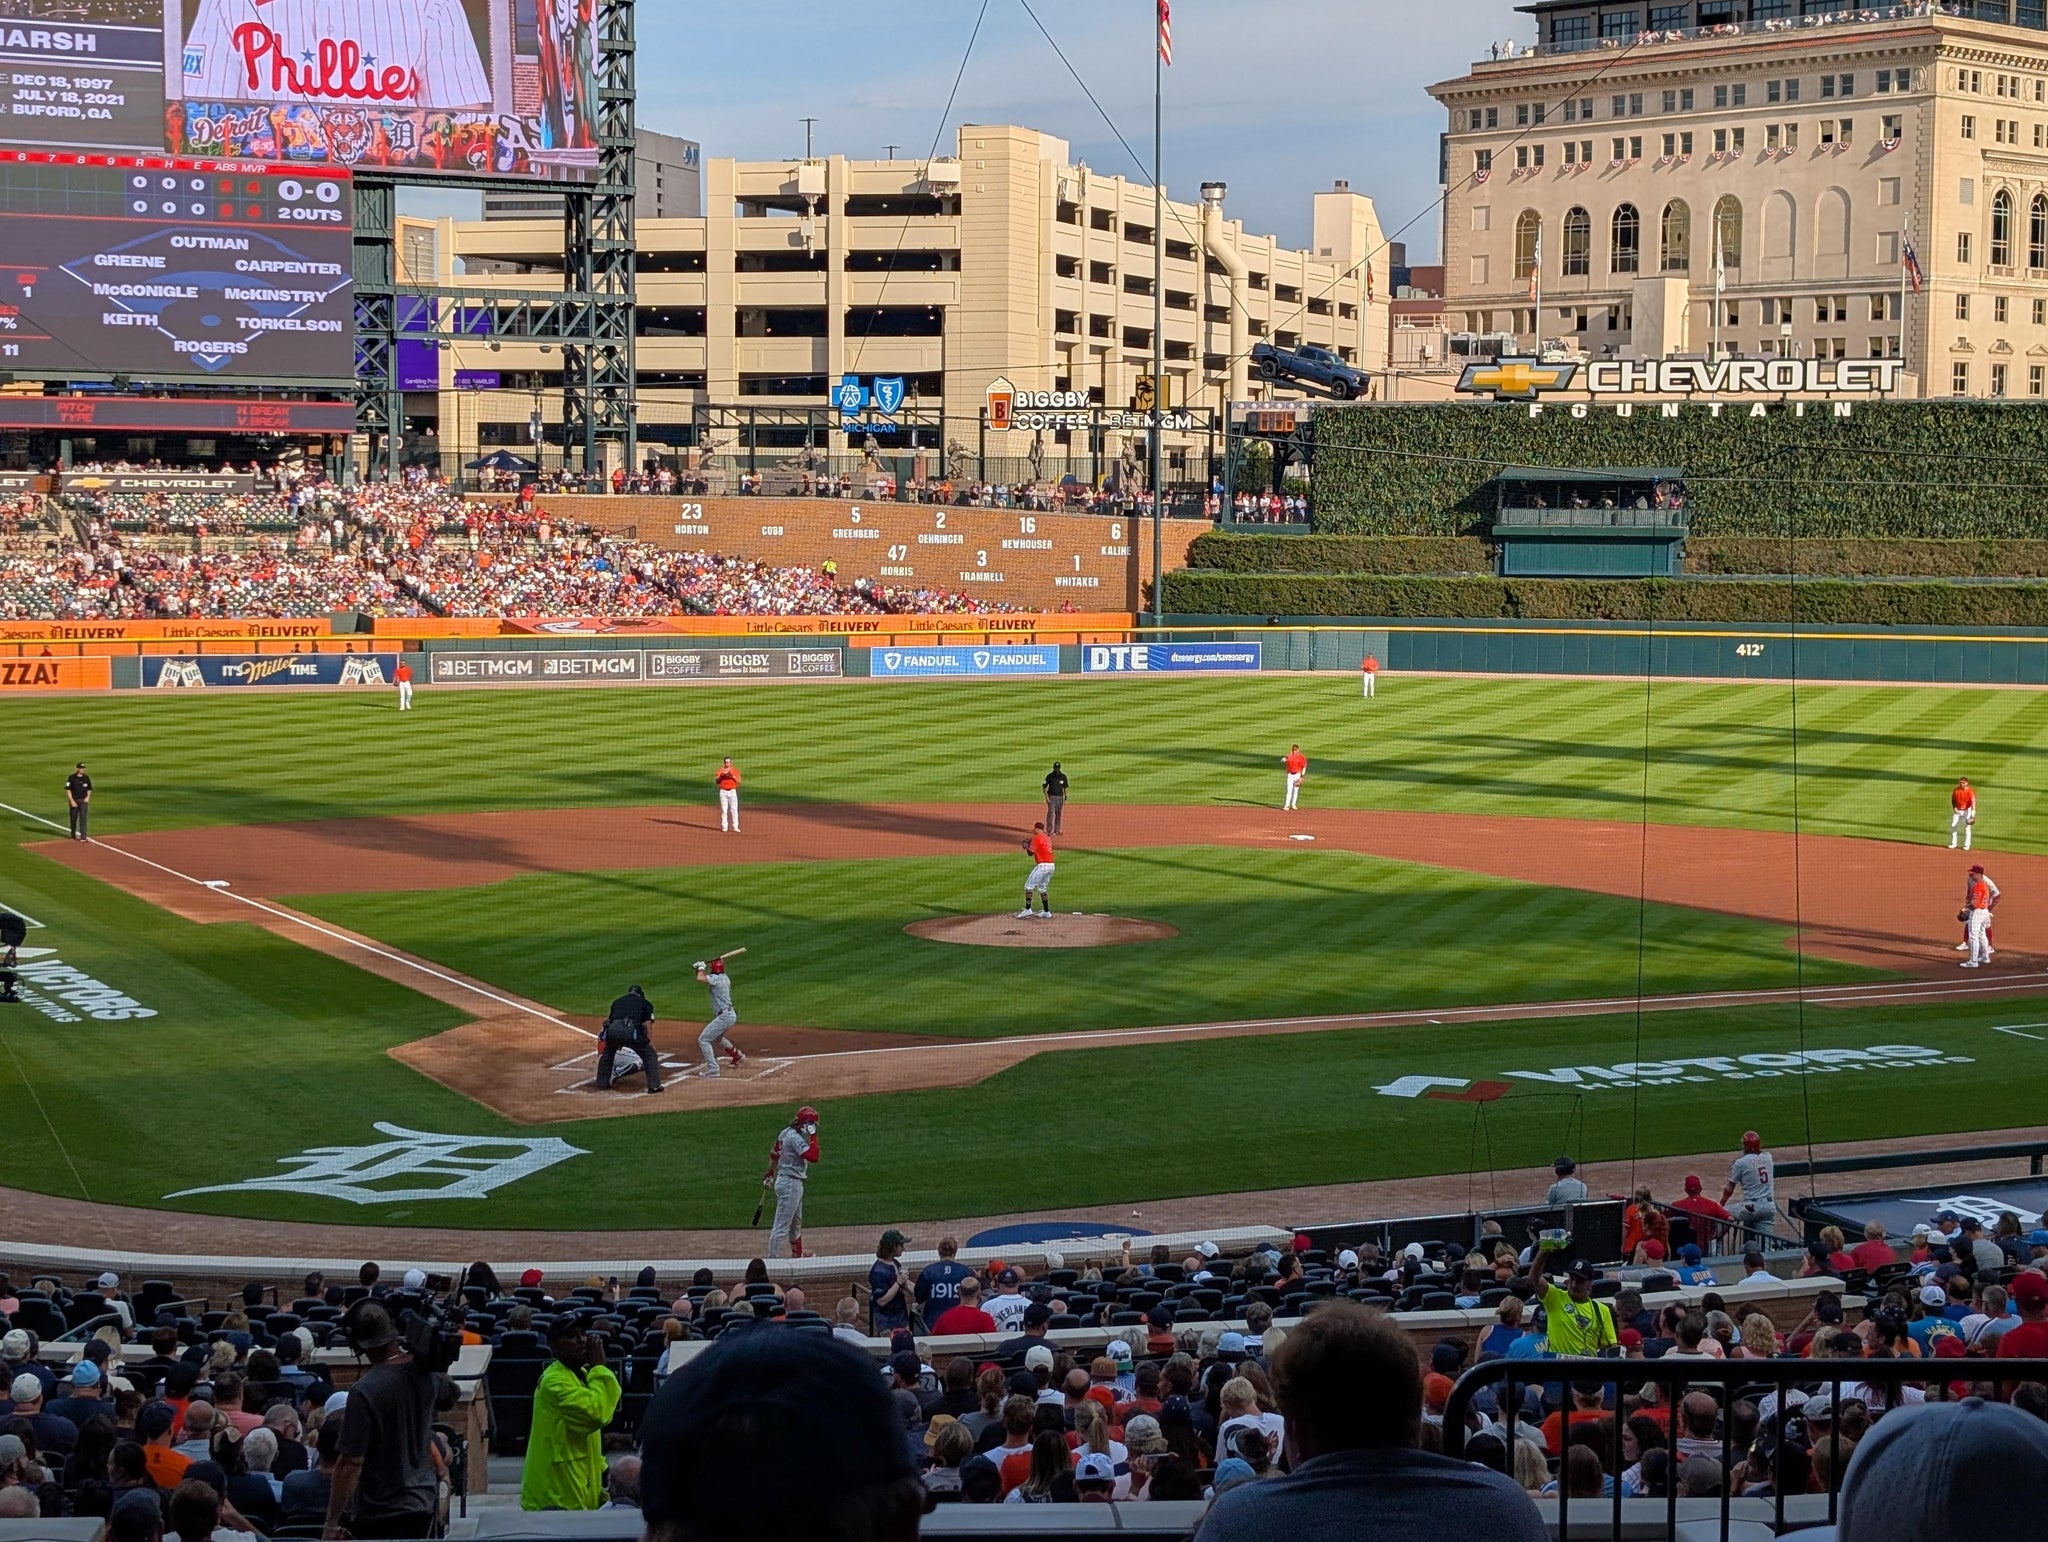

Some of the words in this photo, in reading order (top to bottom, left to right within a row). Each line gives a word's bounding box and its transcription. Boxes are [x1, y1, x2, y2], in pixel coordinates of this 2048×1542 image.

[0, 28, 96, 52] ARSH
[233, 22, 421, 101] Phillies
[12, 74, 46, 86] DEC
[49, 76, 71, 89] 18,
[73, 78, 113, 90] 1997
[12, 89, 58, 101] JULY
[60, 92, 82, 105] 18,
[84, 93, 125, 105] 2021
[12, 104, 86, 120] BUFORD,
[87, 108, 113, 119] GA
[191, 106, 270, 148] Detroit
[18, 153, 26, 161] 6
[48, 154, 56, 162] 7
[77, 155, 86, 164] 8
[107, 157, 115, 166] 9
[136, 159, 145, 167] R
[164, 161, 174, 169] H
[194, 162, 202, 170] E
[214, 163, 237, 172] ABS
[241, 164, 266, 173] MVR
[133, 176, 147, 188] 0
[162, 177, 176, 190] 0
[191, 179, 205, 191] 0
[133, 200, 148, 213] 0
[162, 201, 177, 214] 0
[191, 203, 206, 215] 0
[278, 207, 290, 219] 2
[292, 209, 342, 221] OUTS
[170, 236, 249, 250] OUTMAN
[94, 254, 166, 268] GREENE
[235, 259, 342, 275] CARPENTER
[23, 286, 32, 297] 1
[94, 284, 198, 298] McGONIGLE
[225, 288, 328, 303] McKINSTRY
[103, 313, 158, 326] KEITH
[236, 317, 342, 332] TORKELSON
[174, 341, 248, 354] ROGERS
[1587, 358, 1906, 393] CHEVROLET
[56, 402, 95, 412] PITCH
[251, 406, 290, 416] BREAK
[1529, 402, 1852, 418] FOUNTAIN
[60, 413, 93, 423] TYPE
[251, 416, 290, 426] BREAK
[1015, 413, 1090, 431] COFFEE
[1110, 413, 1192, 430] BETMGM
[842, 422, 896, 434] MICHIGAN
[120, 479, 237, 489] CHEVROLET
[682, 503, 703, 520] 23
[851, 506, 861, 523] 5
[935, 511, 946, 529] 2
[1019, 516, 1036, 534] 16
[675, 524, 710, 536] HORTON
[761, 525, 784, 536] COBB
[832, 528, 880, 540] GREENBERG
[1110, 523, 1121, 540] 6
[1002, 538, 1053, 550] NEWHOUSER
[1100, 544, 1132, 556] KALINE
[887, 544, 907, 561] 47
[976, 550, 987, 567] 3
[1072, 554, 1080, 572] 1
[880, 565, 914, 577] MORRIS
[959, 571, 1005, 583] TRAMMELL
[1054, 576, 1099, 588] WHITAKER
[163, 626, 194, 638] Little
[196, 626, 242, 638] Caesars
[746, 622, 773, 633] Little
[774, 622, 812, 633] Caesars
[909, 620, 934, 631] Little
[935, 620, 973, 631] Caesars
[559, 658, 635, 674] BETMGM
[904, 655, 959, 667] FANDUEL
[992, 654, 1046, 666] FANDUEL
[1090, 647, 1148, 671] DTE
[2, 663, 58, 685] ZZA!
[242, 656, 299, 684] Miller
[290, 663, 318, 676] TIME
[455, 660, 532, 675] BETMGM
[666, 666, 700, 675] COFFEE
[802, 664, 835, 672] COFFEE
[1499, 1044, 1945, 1083] VICTORS
[1575, 1075, 1714, 1090] HOME
[1722, 1056, 1976, 1079] SOLUTIONS
[1757, 1166, 1768, 1184] 5
[996, 1303, 1028, 1322] VERLAN
